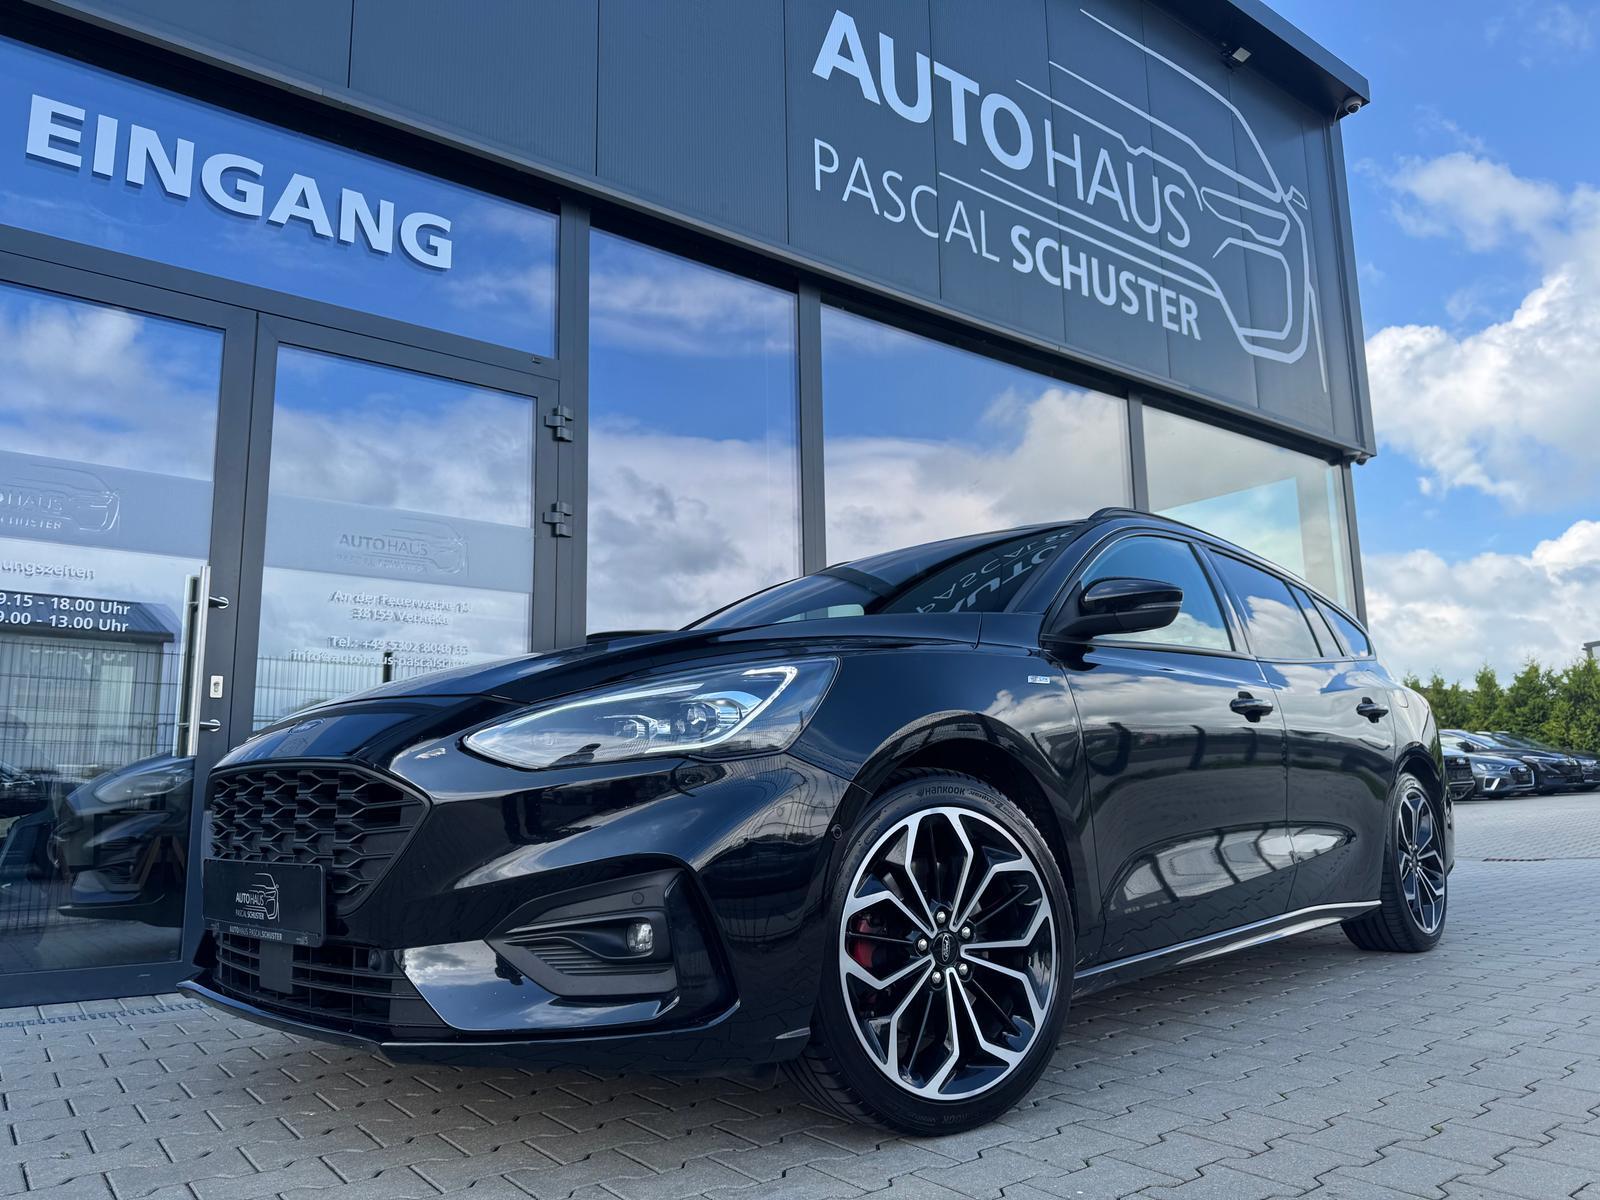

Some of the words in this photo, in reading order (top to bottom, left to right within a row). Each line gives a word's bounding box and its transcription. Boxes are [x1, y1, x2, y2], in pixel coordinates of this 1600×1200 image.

[811, 9, 1192, 249] AUTOHAUS
[25, 94, 453, 269] EINGANG
[813, 138, 1000, 263] PASCAL
[1010, 224, 1202, 341] SCHUSTER
[338, 533, 429, 557] AUTOHAUS
[51, 597, 95, 613] 18.00
[100, 601, 131, 615] Uhr
[49, 614, 94, 630] 13.00
[99, 618, 129, 632] Uhr
[235, 892, 265, 906] AUTOHAUS
